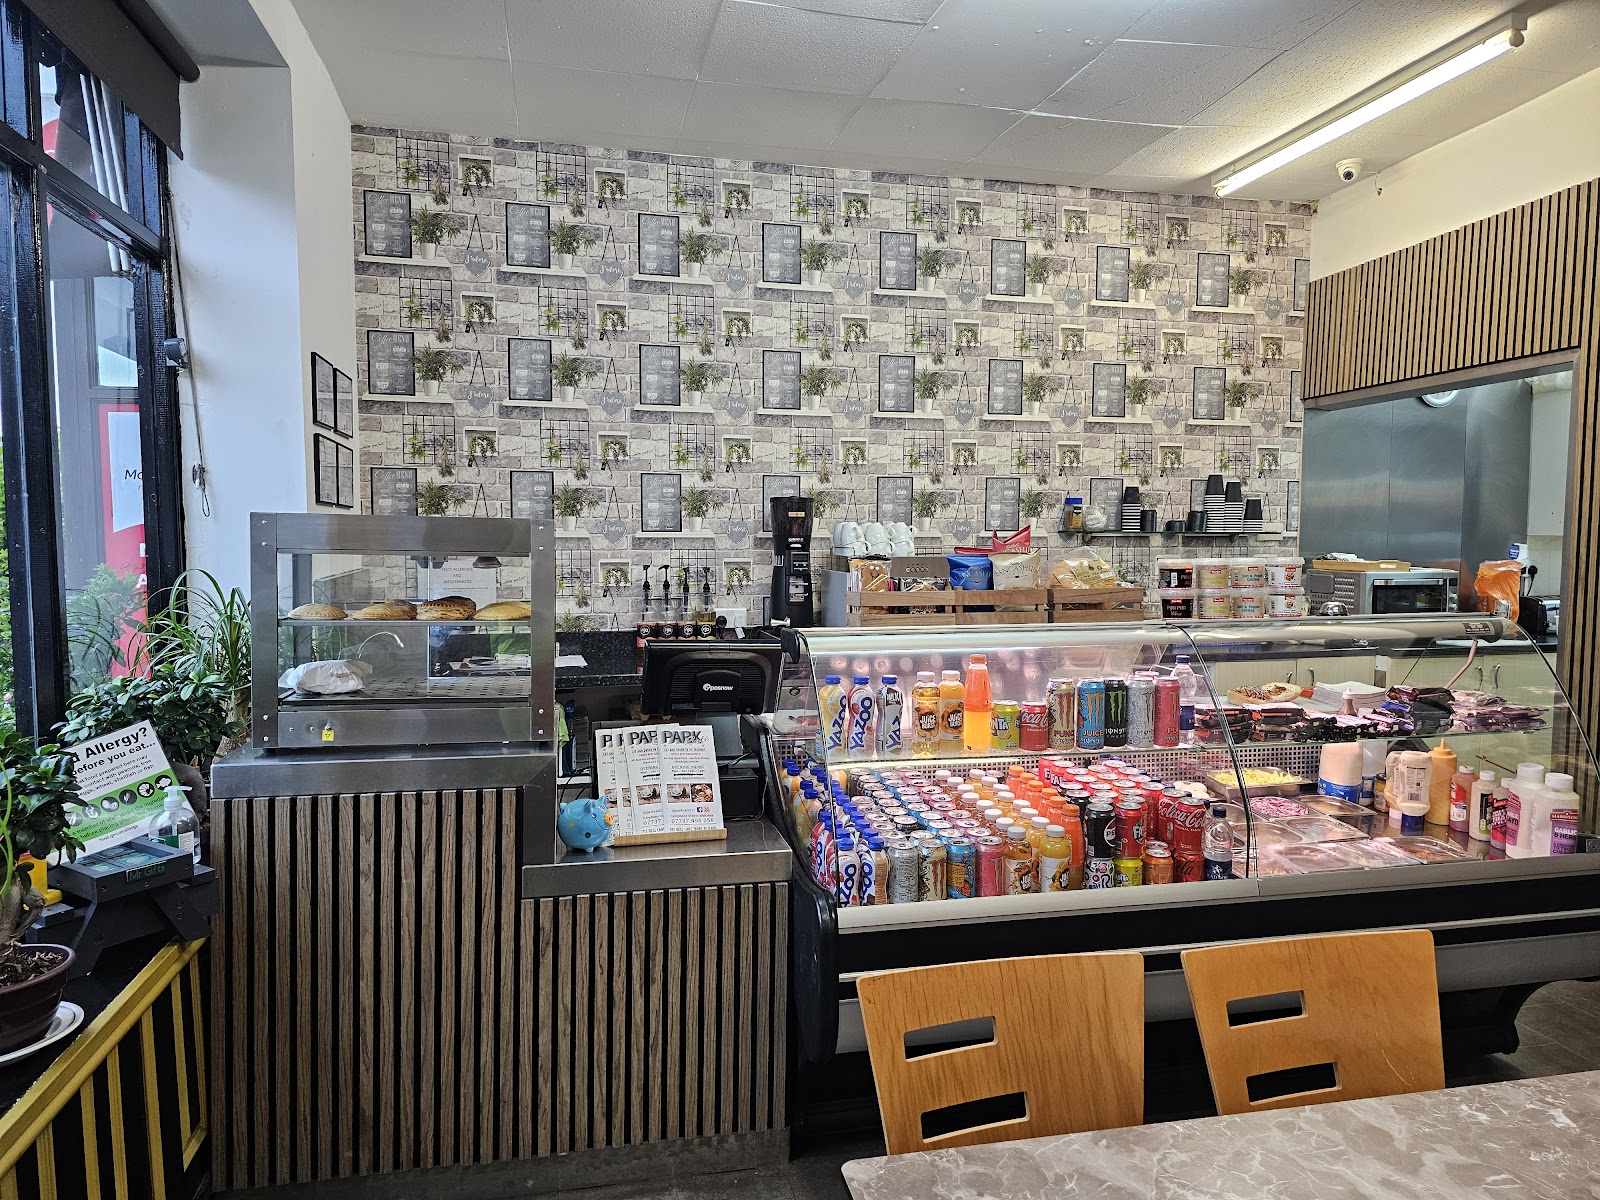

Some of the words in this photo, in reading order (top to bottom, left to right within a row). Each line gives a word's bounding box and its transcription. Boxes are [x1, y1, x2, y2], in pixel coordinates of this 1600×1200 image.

[850, 696, 873, 750] YAZOO
[85, 727, 147, 758] Allergy?
[662, 731, 702, 744] PARK
[108, 751, 126, 763] you
[129, 869, 141, 881] Mr
[143, 864, 165, 878] Gifts
